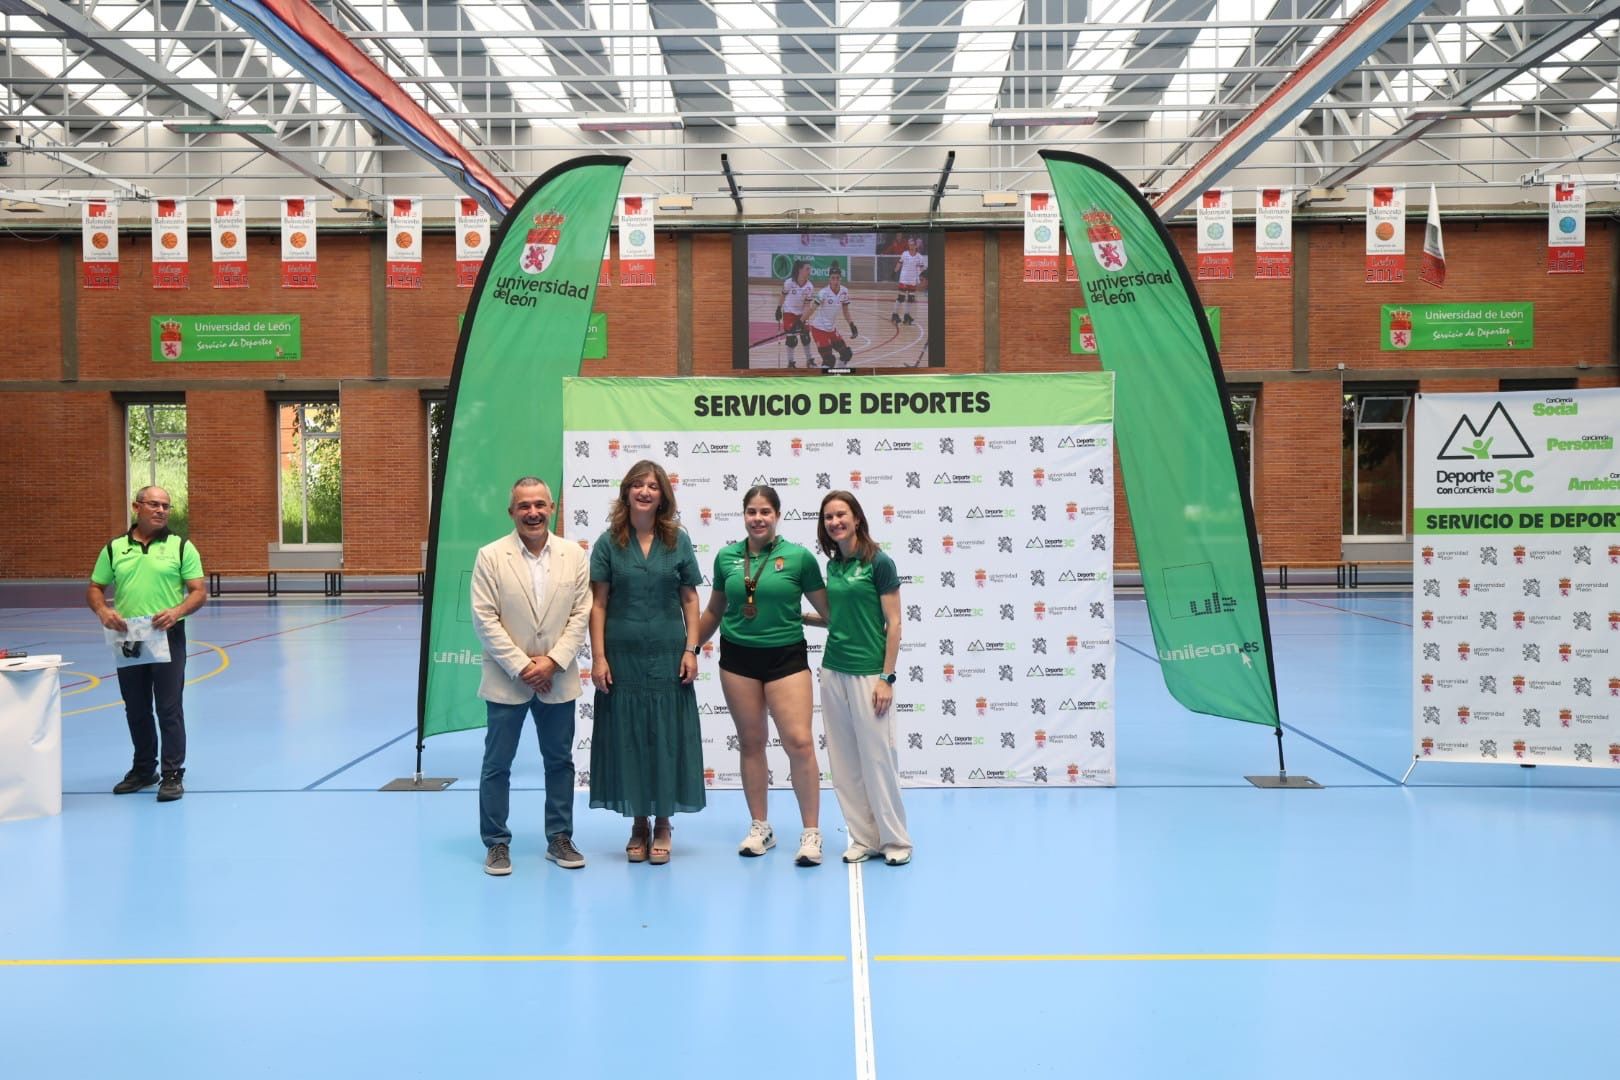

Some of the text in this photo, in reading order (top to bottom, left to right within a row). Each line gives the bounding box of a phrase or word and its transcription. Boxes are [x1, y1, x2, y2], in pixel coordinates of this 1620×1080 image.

[496, 276, 589, 300] universidad
[1086, 270, 1172, 292] universidad
[493, 288, 537, 307] de león
[1090, 288, 1136, 306] de león
[1425, 310, 1524, 320] Universidad de León
[194, 321, 291, 332] Universidad de León
[1433, 328, 1510, 340] Servicio de Deportes
[197, 338, 273, 350] Servicio de Deportes
[694, 391, 990, 416] SERVICIO DE DEPORTES
[1532, 402, 1578, 416] Social
[1546, 437, 1613, 451] Personal
[1437, 469, 1534, 494] Deporte 3C
[1426, 514, 1513, 529] SERVICIO
[1519, 513, 1543, 528] DE
[433, 650, 482, 665] unile
[1160, 642, 1259, 660] unileon.es
